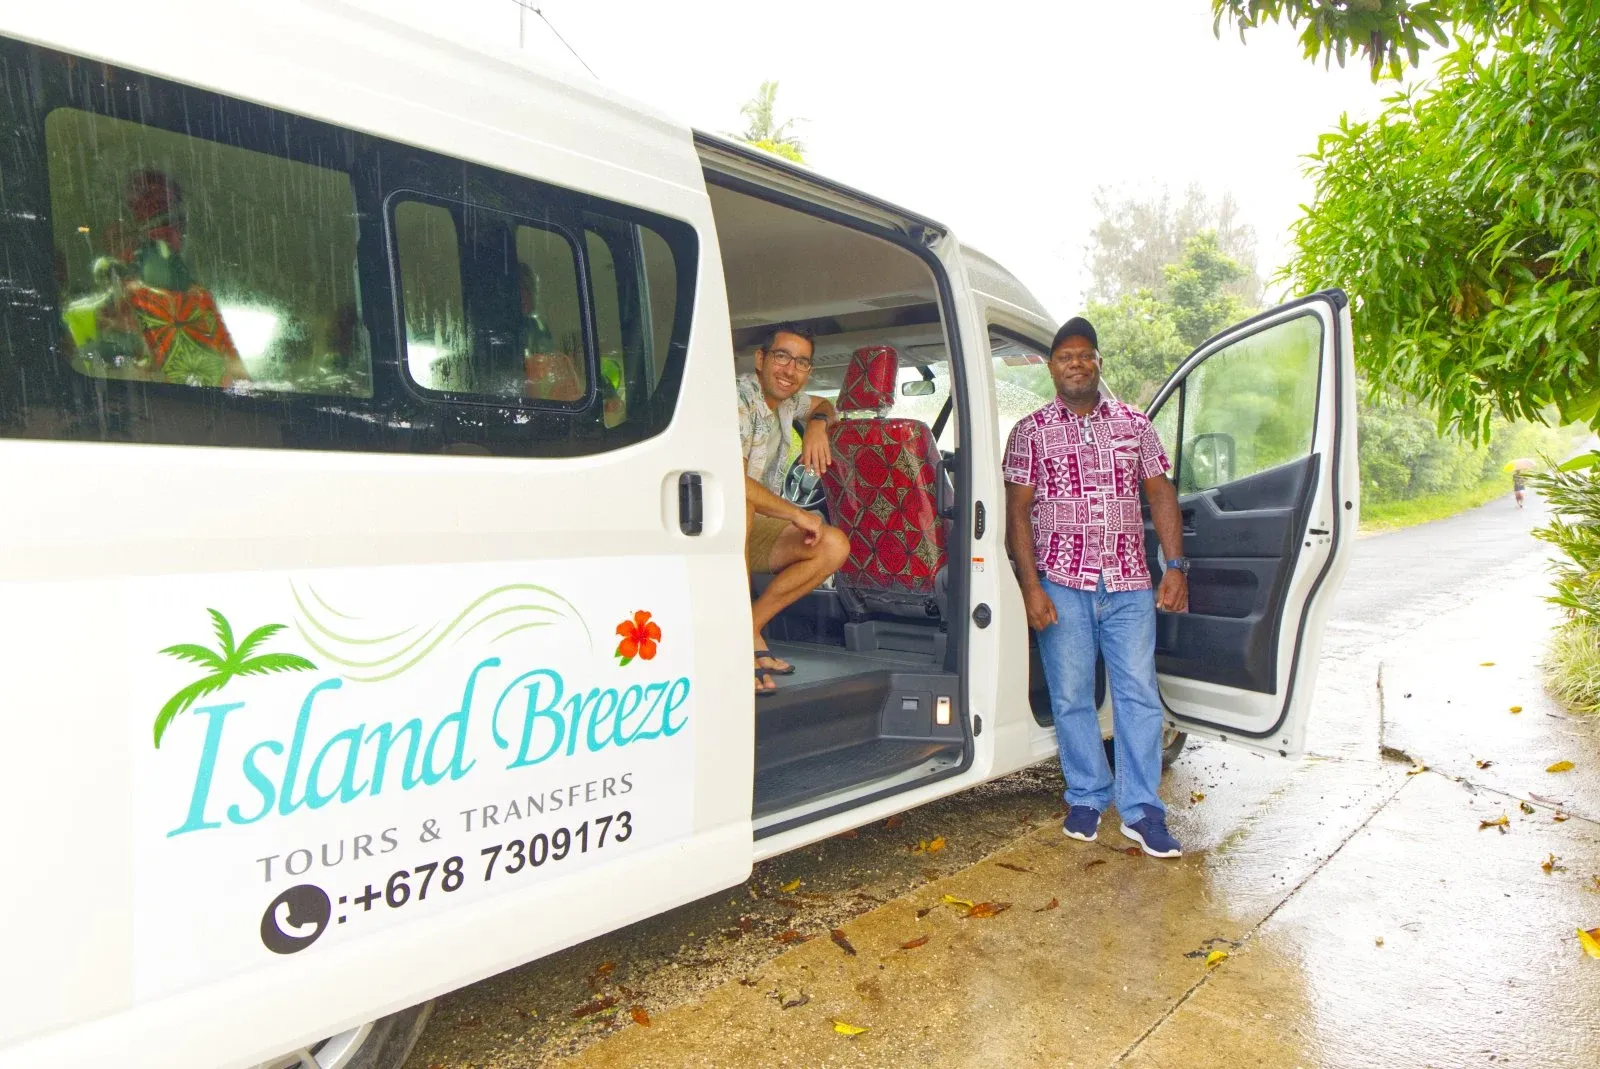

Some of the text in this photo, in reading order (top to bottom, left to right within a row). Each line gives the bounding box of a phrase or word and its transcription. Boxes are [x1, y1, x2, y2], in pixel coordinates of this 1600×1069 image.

[166, 657, 691, 838] Island Breeze
[256, 772, 634, 883] TOURS & TRANSFERS
[480, 810, 633, 882] 7309173
